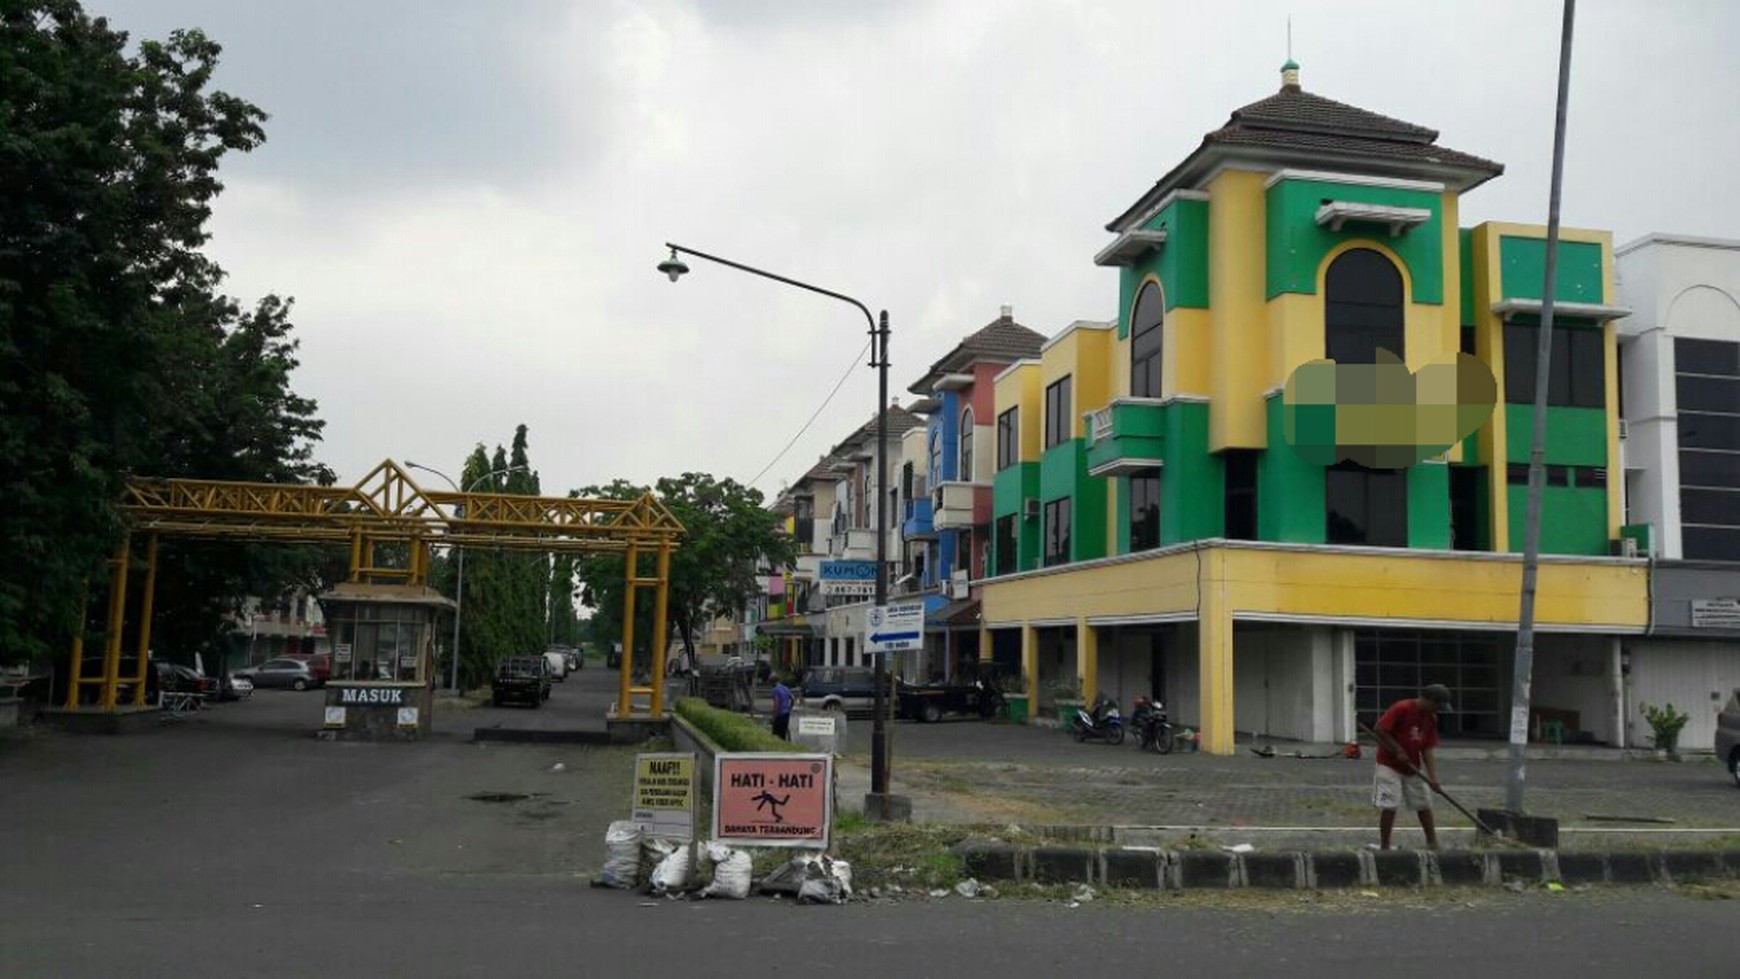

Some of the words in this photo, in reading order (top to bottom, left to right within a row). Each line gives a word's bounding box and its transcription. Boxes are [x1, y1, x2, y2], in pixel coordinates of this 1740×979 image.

[342, 688, 402, 703] MASUK
[730, 773, 765, 788] HATI
[778, 773, 814, 788] HATI
